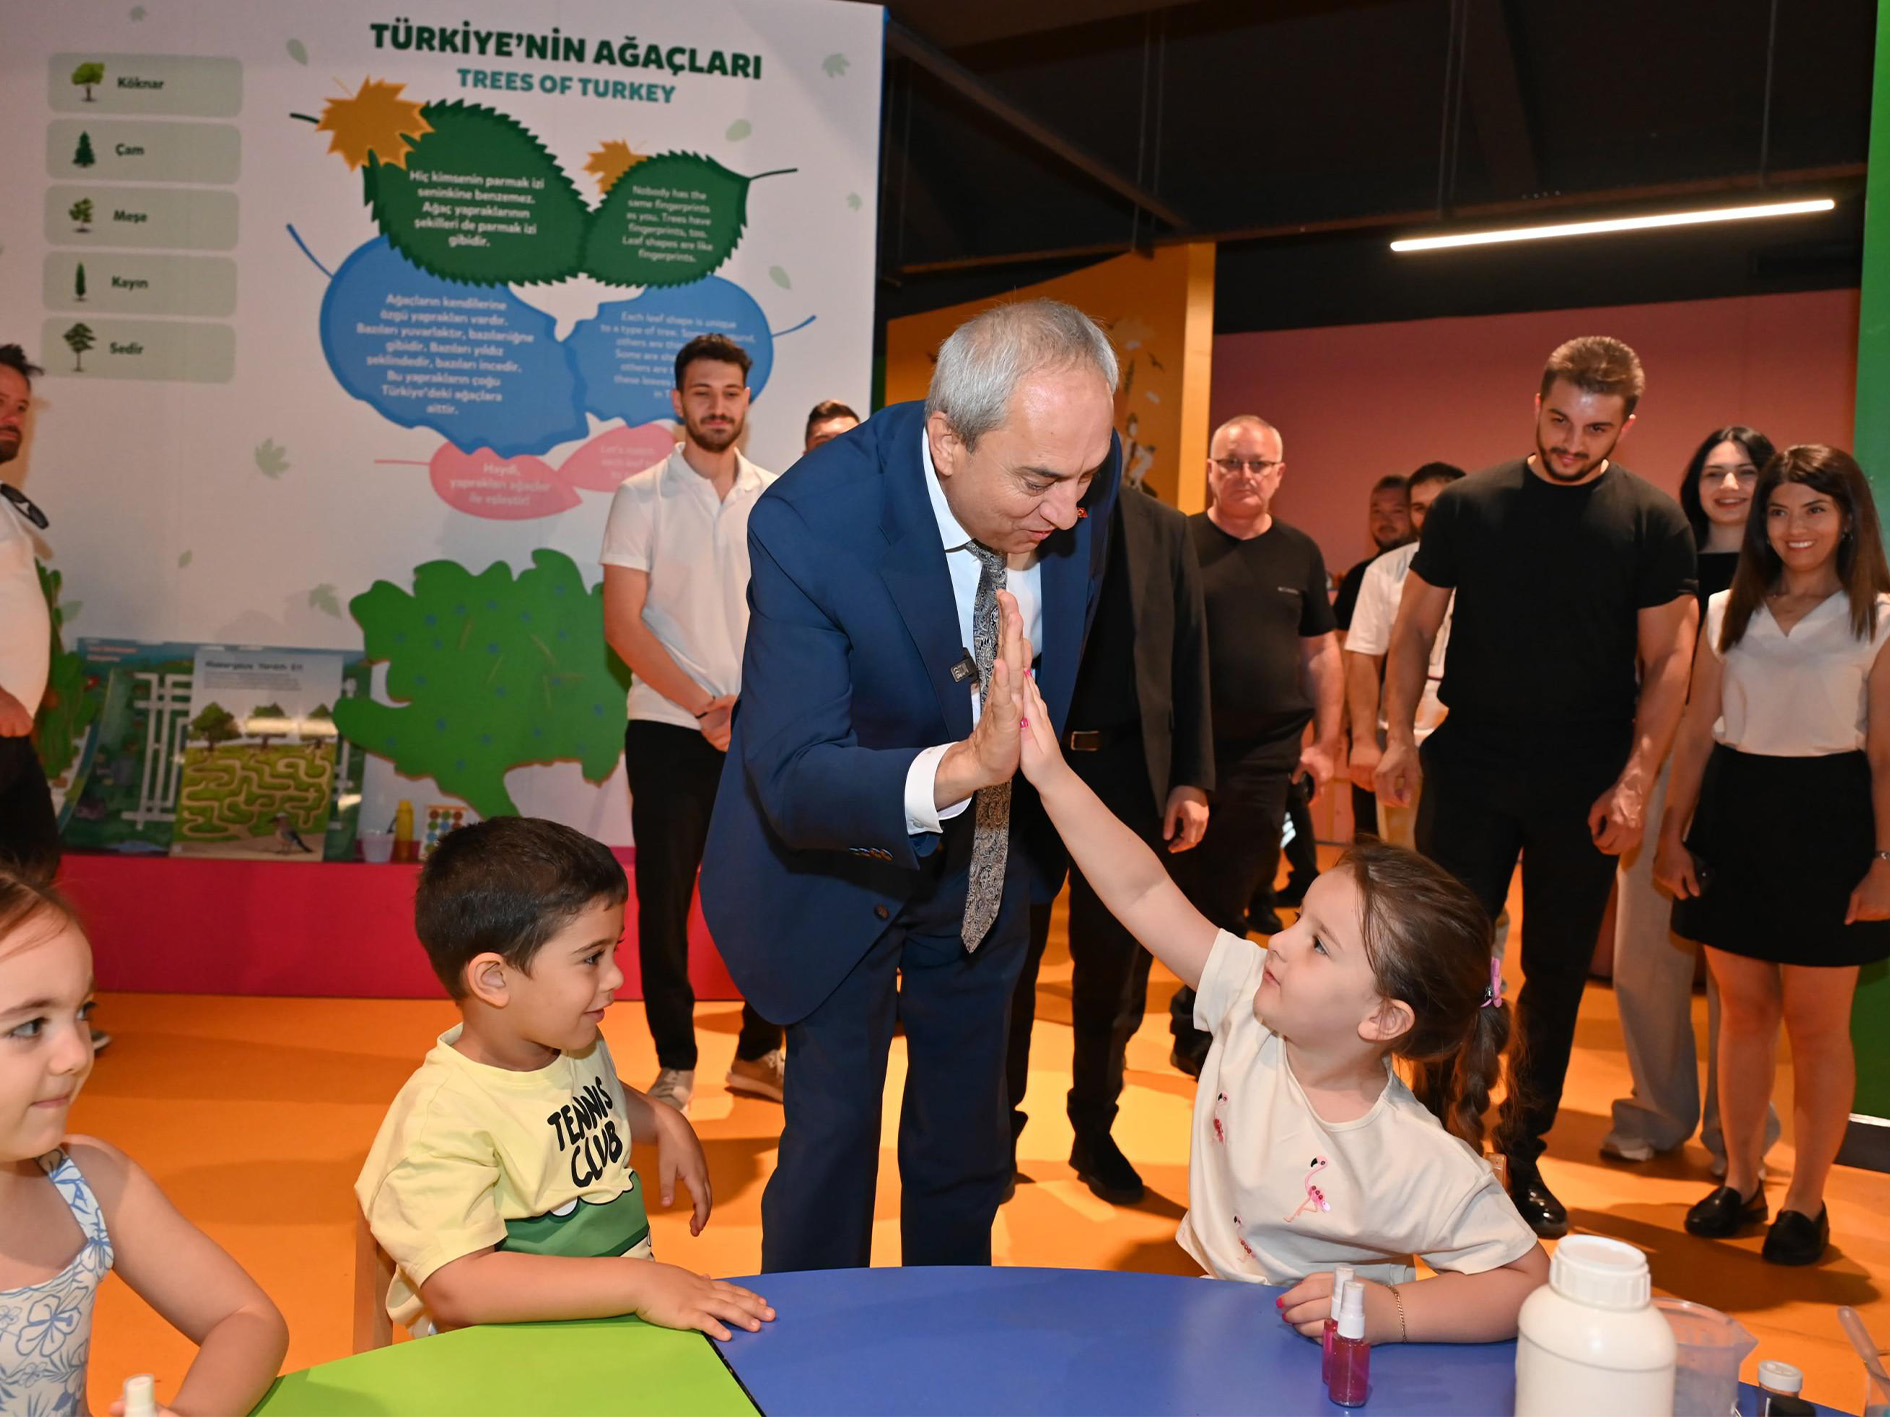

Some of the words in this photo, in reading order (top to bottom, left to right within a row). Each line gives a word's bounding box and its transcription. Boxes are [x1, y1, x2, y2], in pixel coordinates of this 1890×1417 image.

[593, 36, 762, 80] AĞAÇLARI
[117, 76, 164, 89] Köknar
[457, 68, 534, 92] TREES
[539, 74, 573, 95] OF
[579, 78, 675, 103] TURKEY
[115, 143, 145, 157] Çam
[410, 170, 429, 183] Hiç
[431, 171, 484, 185] kimsenin
[485, 177, 529, 188] parmak
[532, 178, 545, 189] izi
[417, 187, 473, 200] seninkine
[474, 189, 535, 204] benzemez.
[632, 185, 670, 198] Nobody
[672, 188, 689, 199] has
[690, 190, 707, 200] the
[422, 201, 452, 215] Ağaç
[454, 204, 530, 218] yapraklarının
[628, 199, 653, 208] same
[655, 199, 711, 213] fingerprints
[113, 209, 148, 224] Meşe
[662, 212, 687, 223] Trees
[688, 215, 712, 226] have
[414, 217, 459, 230] şekilleri
[461, 219, 476, 232] de
[477, 221, 522, 233] parmak
[523, 223, 537, 235] izi
[448, 234, 490, 248] gibidir.
[622, 235, 644, 245] Leaf
[645, 237, 678, 249] shapes
[680, 241, 695, 250] are
[696, 240, 713, 251] like
[111, 275, 149, 291] Kayın
[621, 312, 644, 322] Each
[646, 312, 664, 323] leaf
[620, 324, 642, 336] type
[109, 341, 144, 355] Sedir
[547, 1076, 613, 1151] TENNIS
[571, 1120, 623, 1188] CLUB
